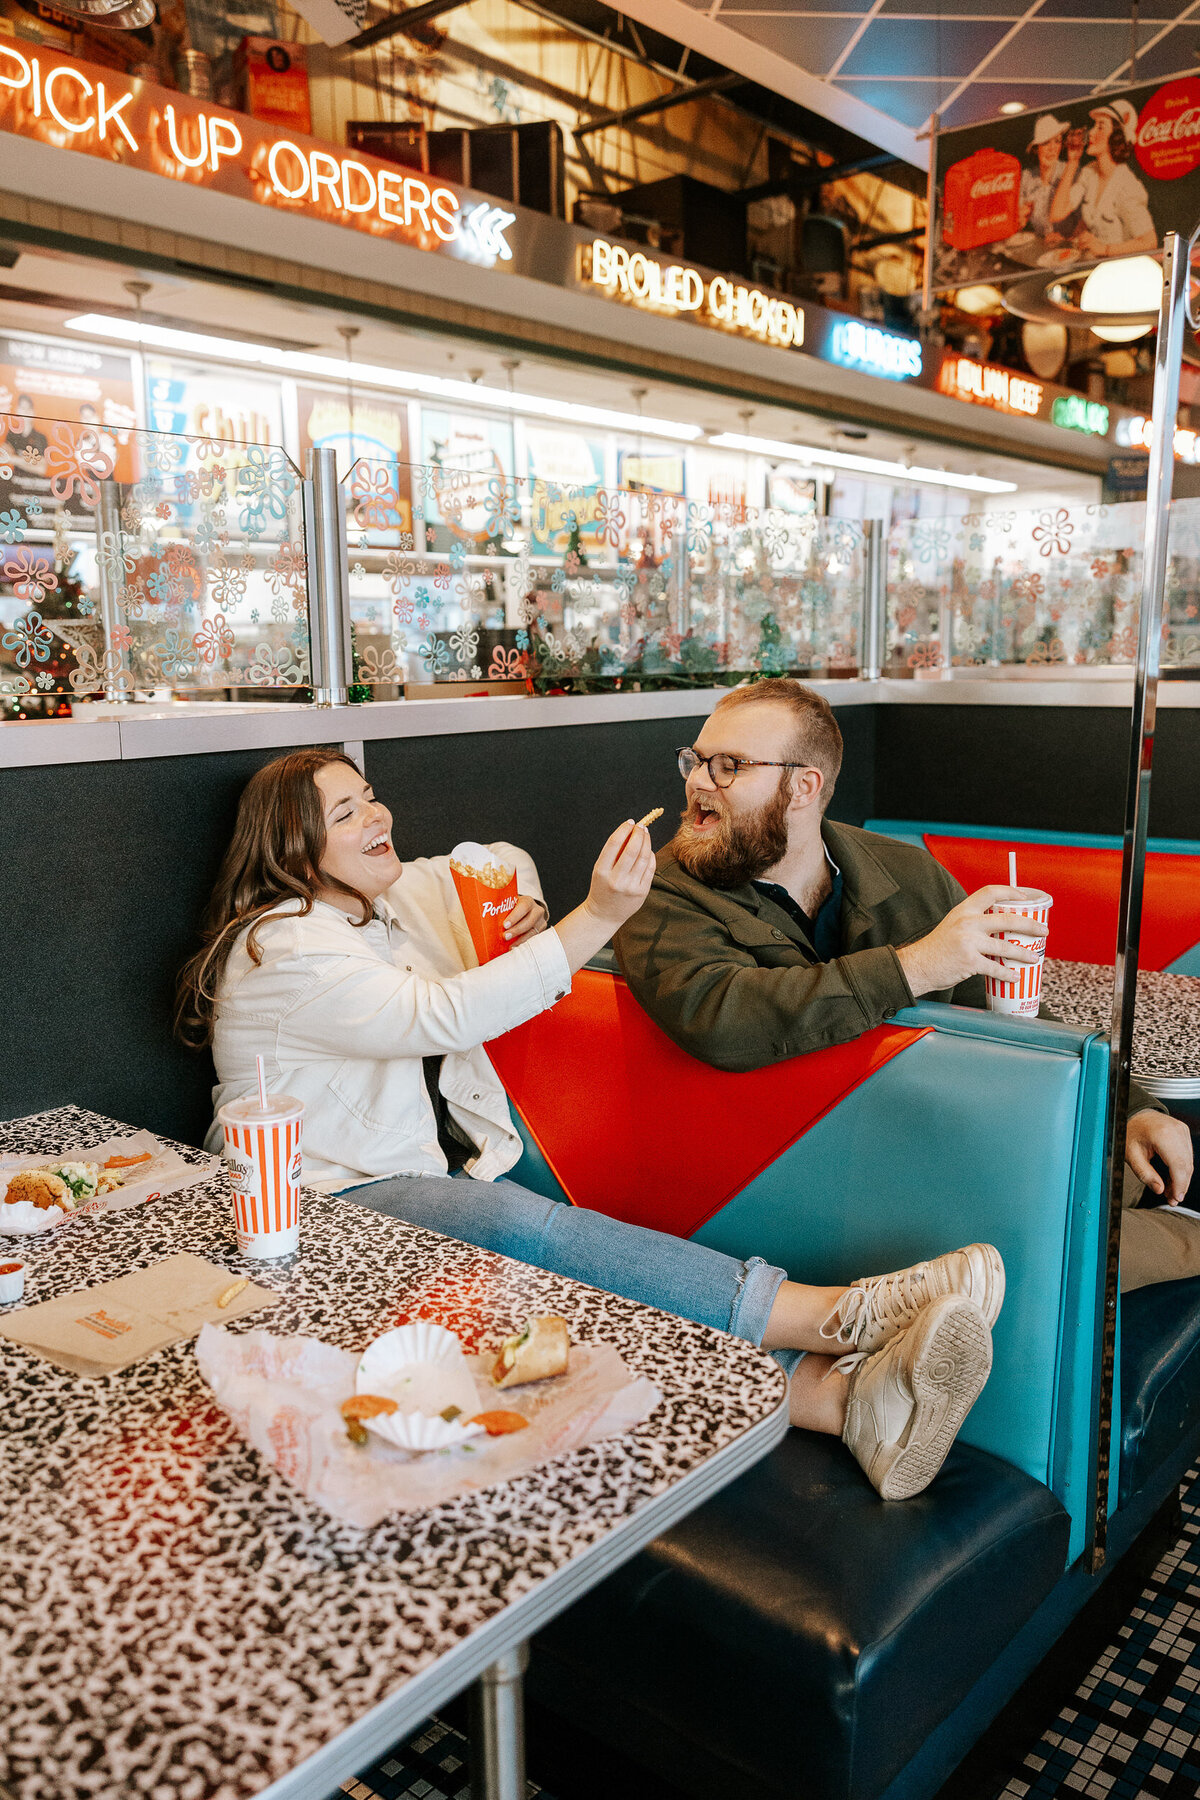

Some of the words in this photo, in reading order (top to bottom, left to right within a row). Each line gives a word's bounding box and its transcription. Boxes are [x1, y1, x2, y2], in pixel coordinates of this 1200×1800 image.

[165, 104, 243, 171] UP
[267, 140, 460, 242] ORDERS
[592, 238, 704, 311] BROILED
[708, 276, 805, 347] CHICKEN
